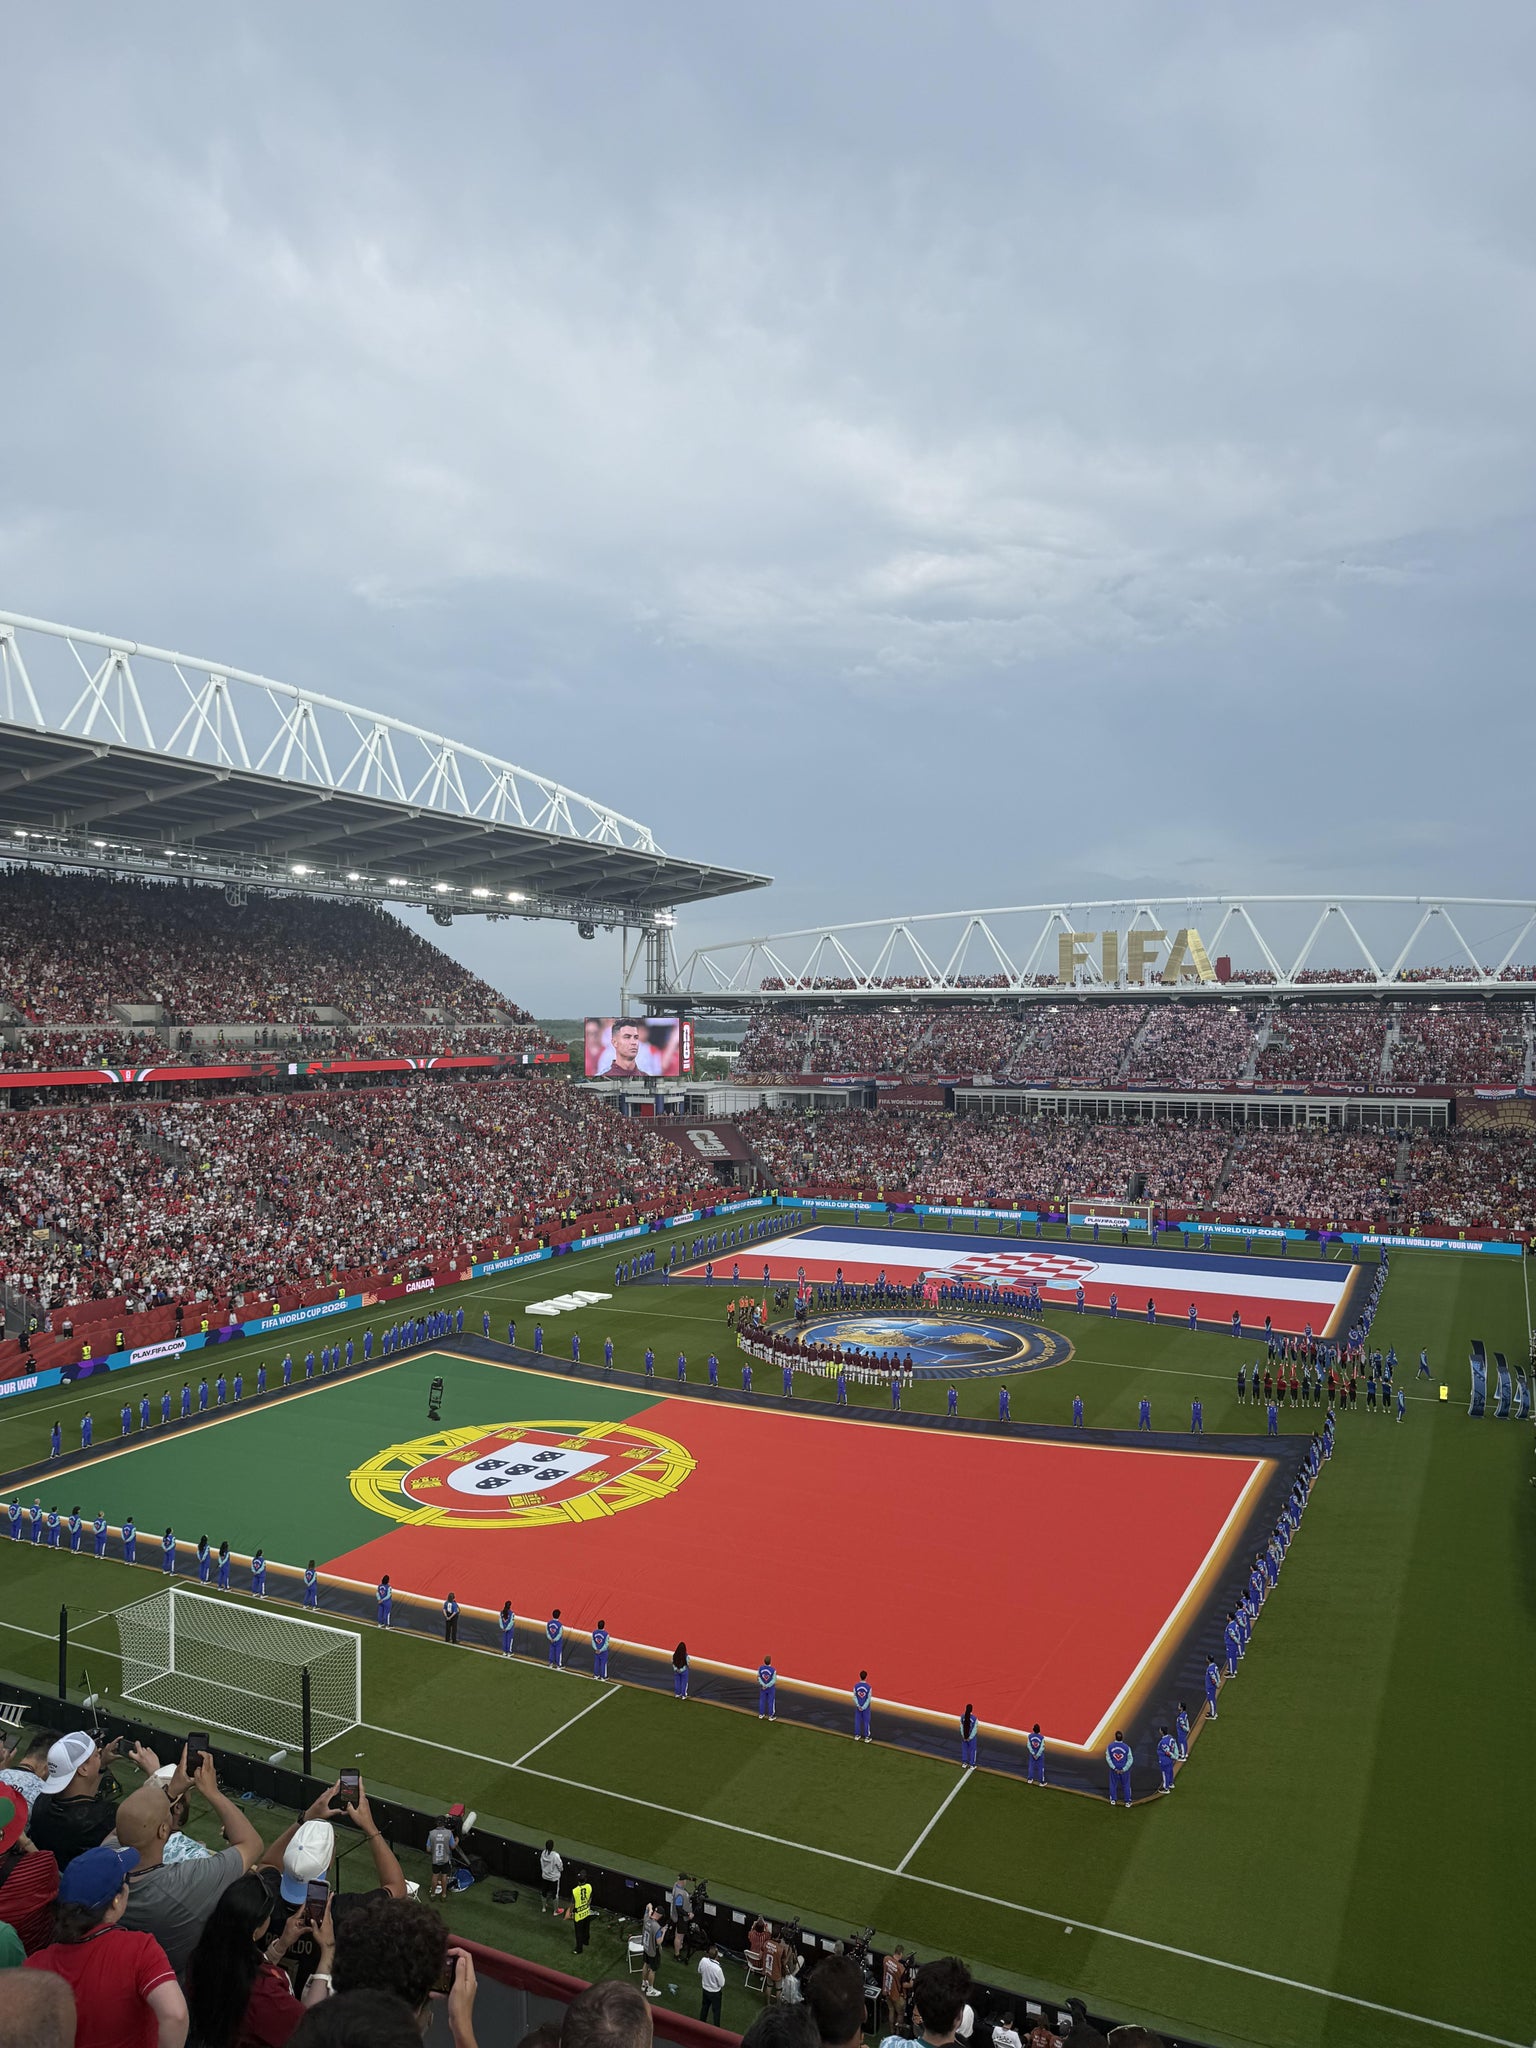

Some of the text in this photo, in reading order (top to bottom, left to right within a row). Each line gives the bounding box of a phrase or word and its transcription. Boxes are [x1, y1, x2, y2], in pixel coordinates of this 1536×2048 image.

[1058, 928, 1217, 983] FIFA
[1347, 1086, 1416, 1094] TOONTO
[1362, 1235, 1379, 1243] PLAY
[1392, 1237, 1406, 1245] FIFA
[1406, 1238, 1430, 1246] WORLD
[1448, 1242, 1467, 1250] YOUR
[483, 1264, 495, 1272] FIFA
[494, 1259, 513, 1270] WORLD
[513, 1256, 523, 1264] CUP
[406, 1277, 435, 1293] CANADA
[261, 1319, 279, 1330] FIFA
[278, 1311, 306, 1325] WORLD
[306, 1308, 322, 1318] CUP
[132, 1340, 185, 1360] PLAY.FIFA.COM
[17, 1376, 38, 1391] WAY
